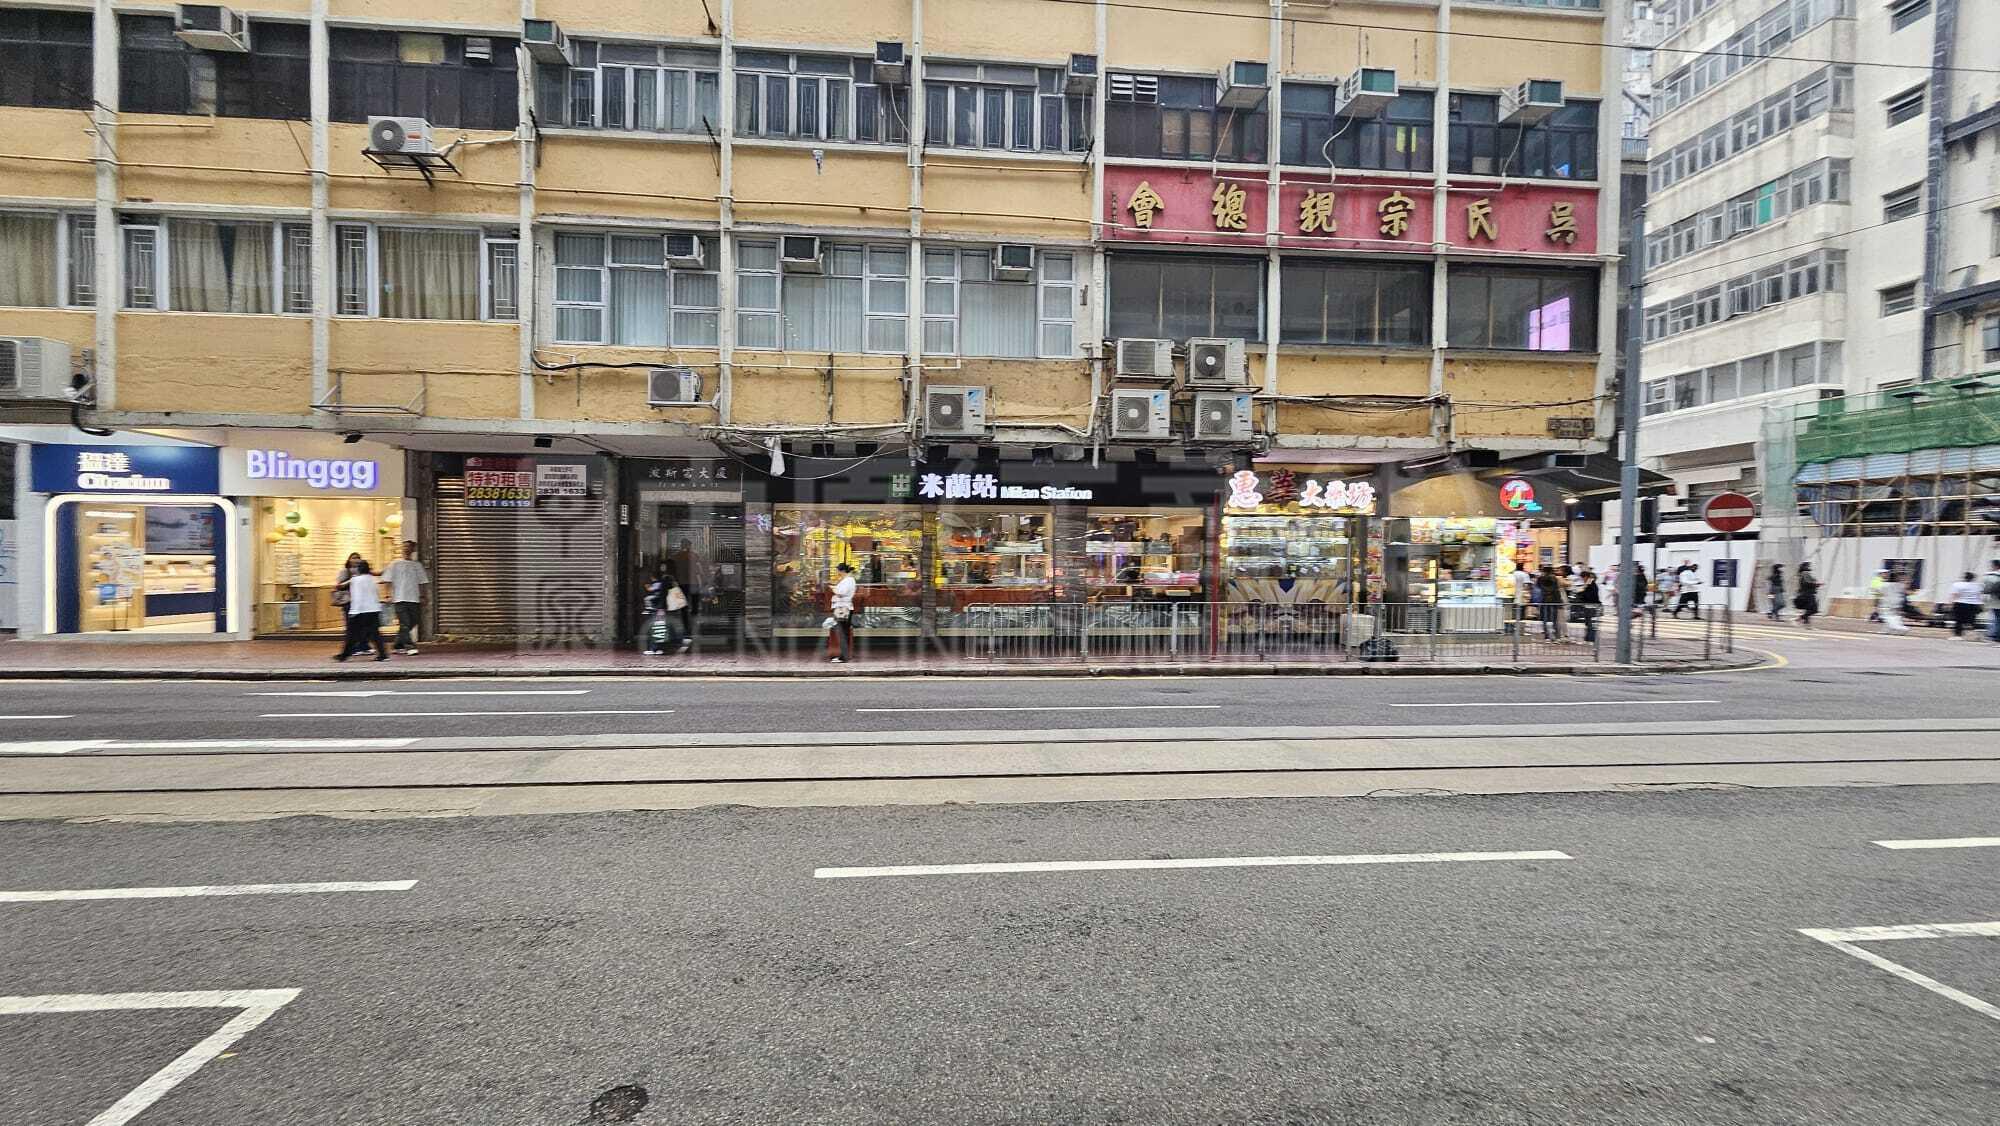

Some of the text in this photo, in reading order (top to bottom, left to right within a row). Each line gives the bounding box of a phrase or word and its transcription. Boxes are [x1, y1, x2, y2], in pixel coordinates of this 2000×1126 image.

[246, 449, 376, 489] Blinggg
[468, 487, 531, 499] 28381633
[918, 472, 998, 498] 米蘭站
[1000, 485, 1093, 499] Milan Station
